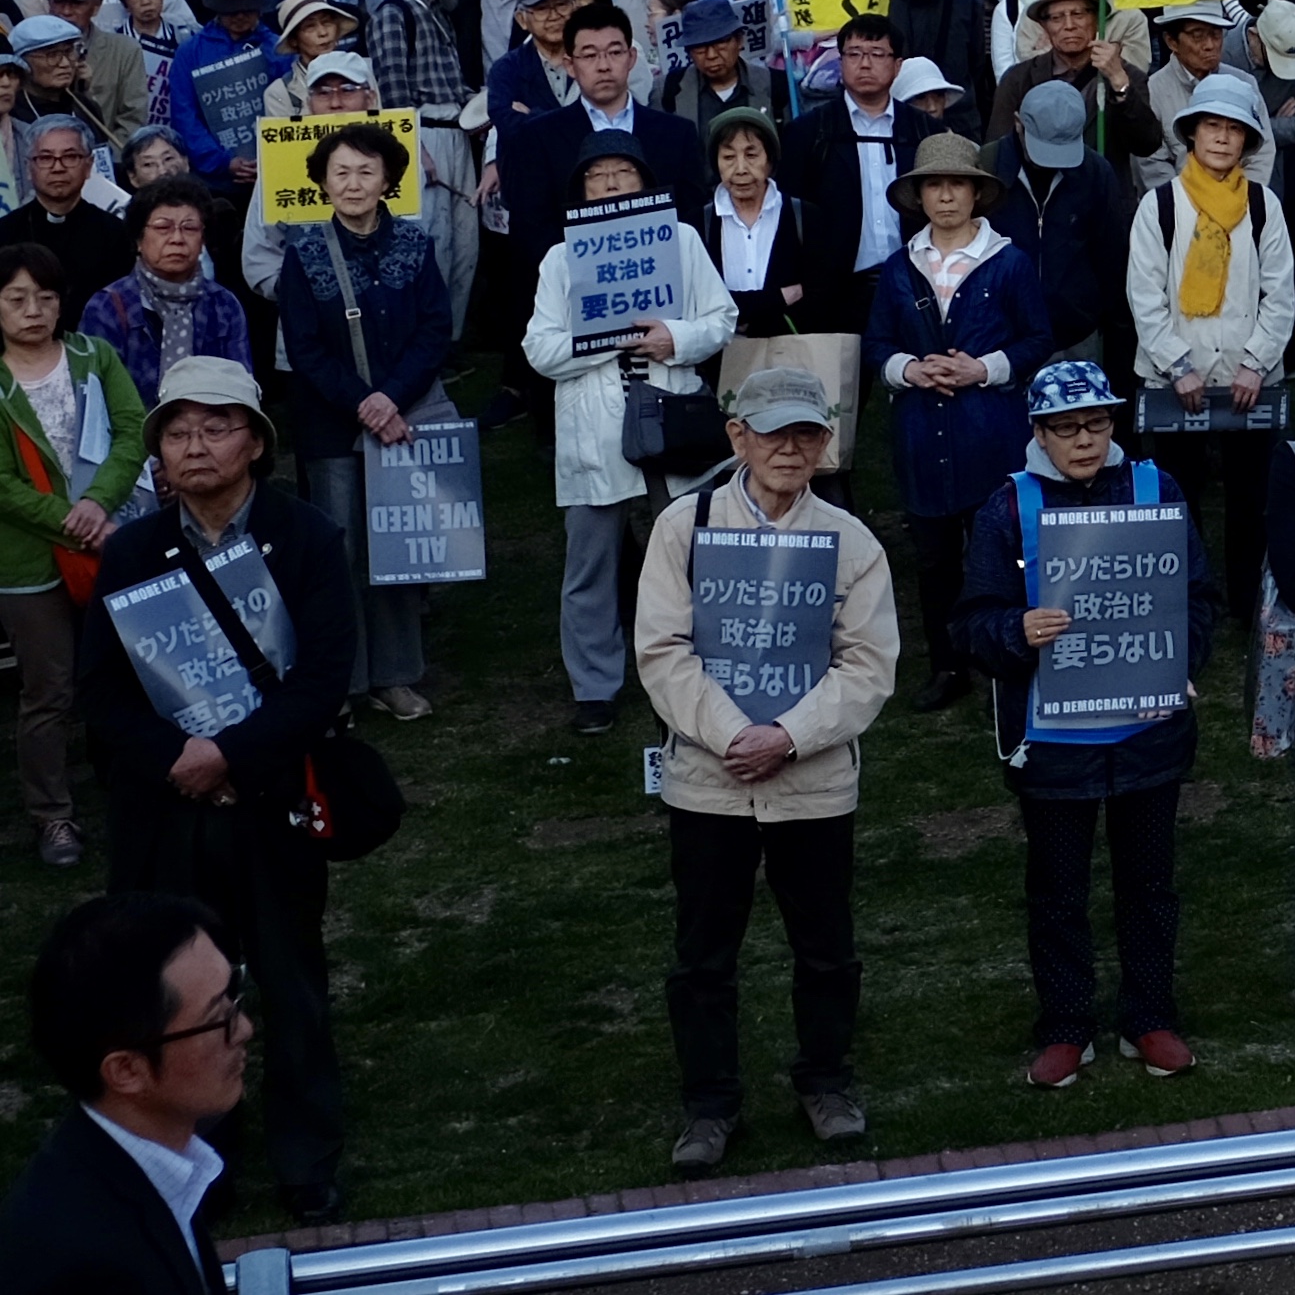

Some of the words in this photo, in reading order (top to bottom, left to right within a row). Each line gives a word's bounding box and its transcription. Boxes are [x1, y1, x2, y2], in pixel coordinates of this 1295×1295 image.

[202, 72, 269, 106] ウソだらけの
[221, 97, 263, 122] 政治は
[573, 224, 672, 258] ウソだらけの
[596, 257, 655, 283] 政治は
[581, 284, 673, 321] 要らない
[575, 340, 589, 352] NO
[381, 437, 465, 468] TRUTH
[410, 471, 437, 500] IS
[371, 505, 433, 533] NEED
[440, 501, 481, 530] WE
[1041, 512, 1058, 525] NO
[1058, 511, 1089, 525] MORE
[1090, 510, 1109, 525] LIE,
[1110, 509, 1126, 523] NO
[1127, 508, 1159, 523] MORE
[1159, 507, 1184, 521] ABE.
[404, 536, 448, 564] ALL
[697, 532, 712, 545] NO
[712, 533, 740, 546] MORE
[741, 533, 759, 547] LIE,
[760, 534, 776, 547] NO
[777, 534, 810, 548] MORE
[811, 535, 835, 549] ABE.
[110, 596, 129, 612] NO
[129, 582, 162, 604] MORE
[161, 576, 181, 594] LIE,
[180, 570, 192, 586] N
[204, 552, 229, 573] ORE
[227, 540, 254, 561] ABE.
[1046, 552, 1179, 583] ウソだらけの
[699, 578, 827, 607] ウソだらけの
[1073, 591, 1153, 621] 政治は
[720, 618, 798, 649] 政治は
[1052, 630, 1174, 671] 要らない
[177, 645, 243, 691] 政治
[705, 657, 812, 697] 要らない
[1043, 702, 1060, 715] NO
[1062, 696, 1138, 714] DEMOCRACY,
[1139, 695, 1155, 709] NO
[1157, 692, 1184, 707] LIFE.
